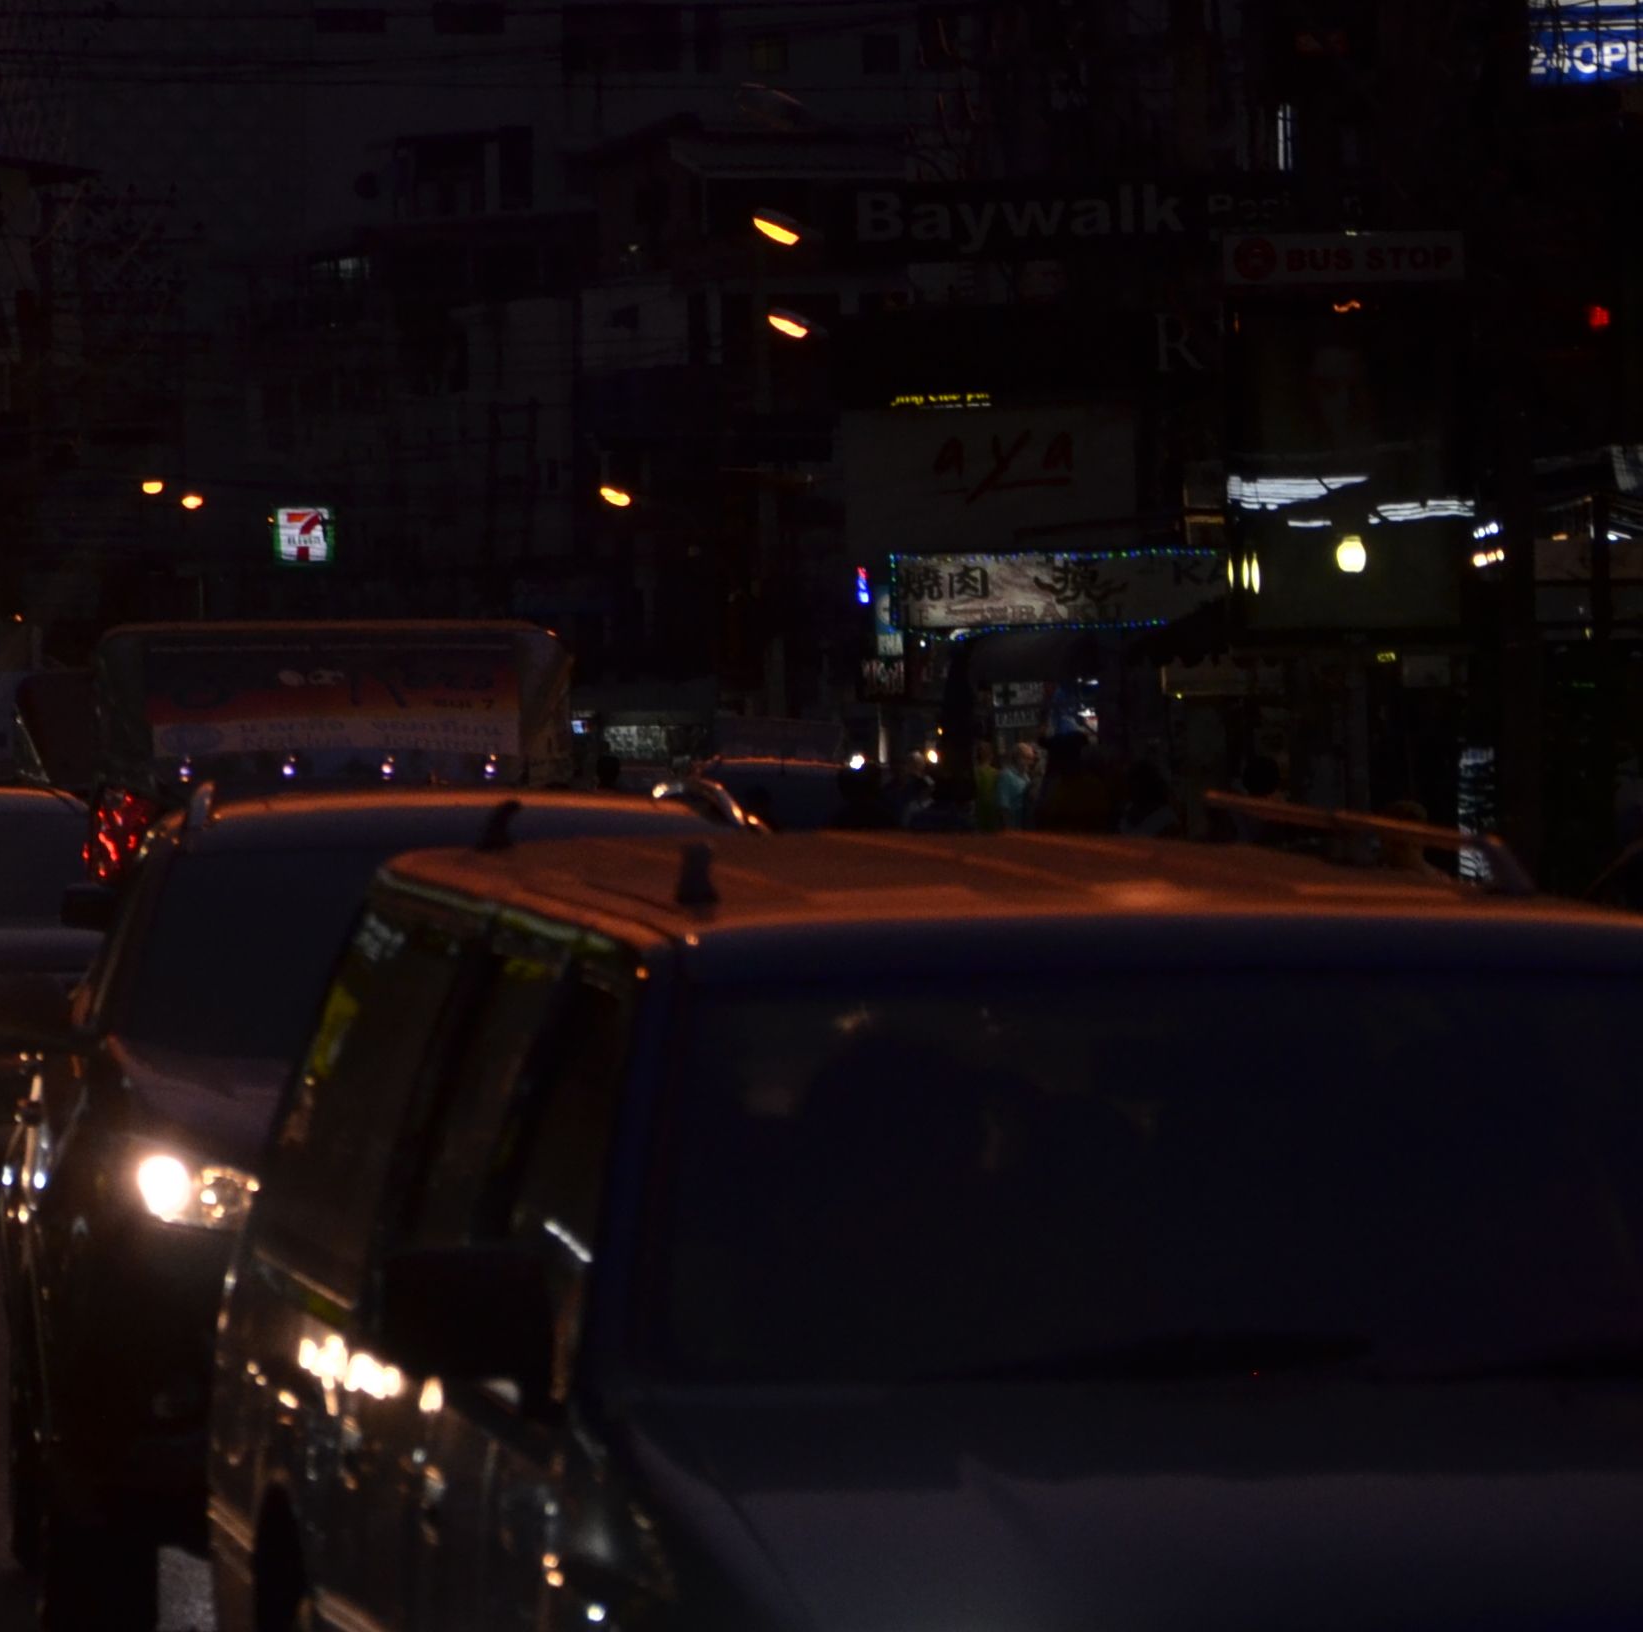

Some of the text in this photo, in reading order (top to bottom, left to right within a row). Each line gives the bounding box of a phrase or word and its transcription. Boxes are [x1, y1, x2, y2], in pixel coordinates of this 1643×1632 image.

[855, 183, 1184, 254] Baywalk
[1284, 244, 1452, 272] BUS STOP
